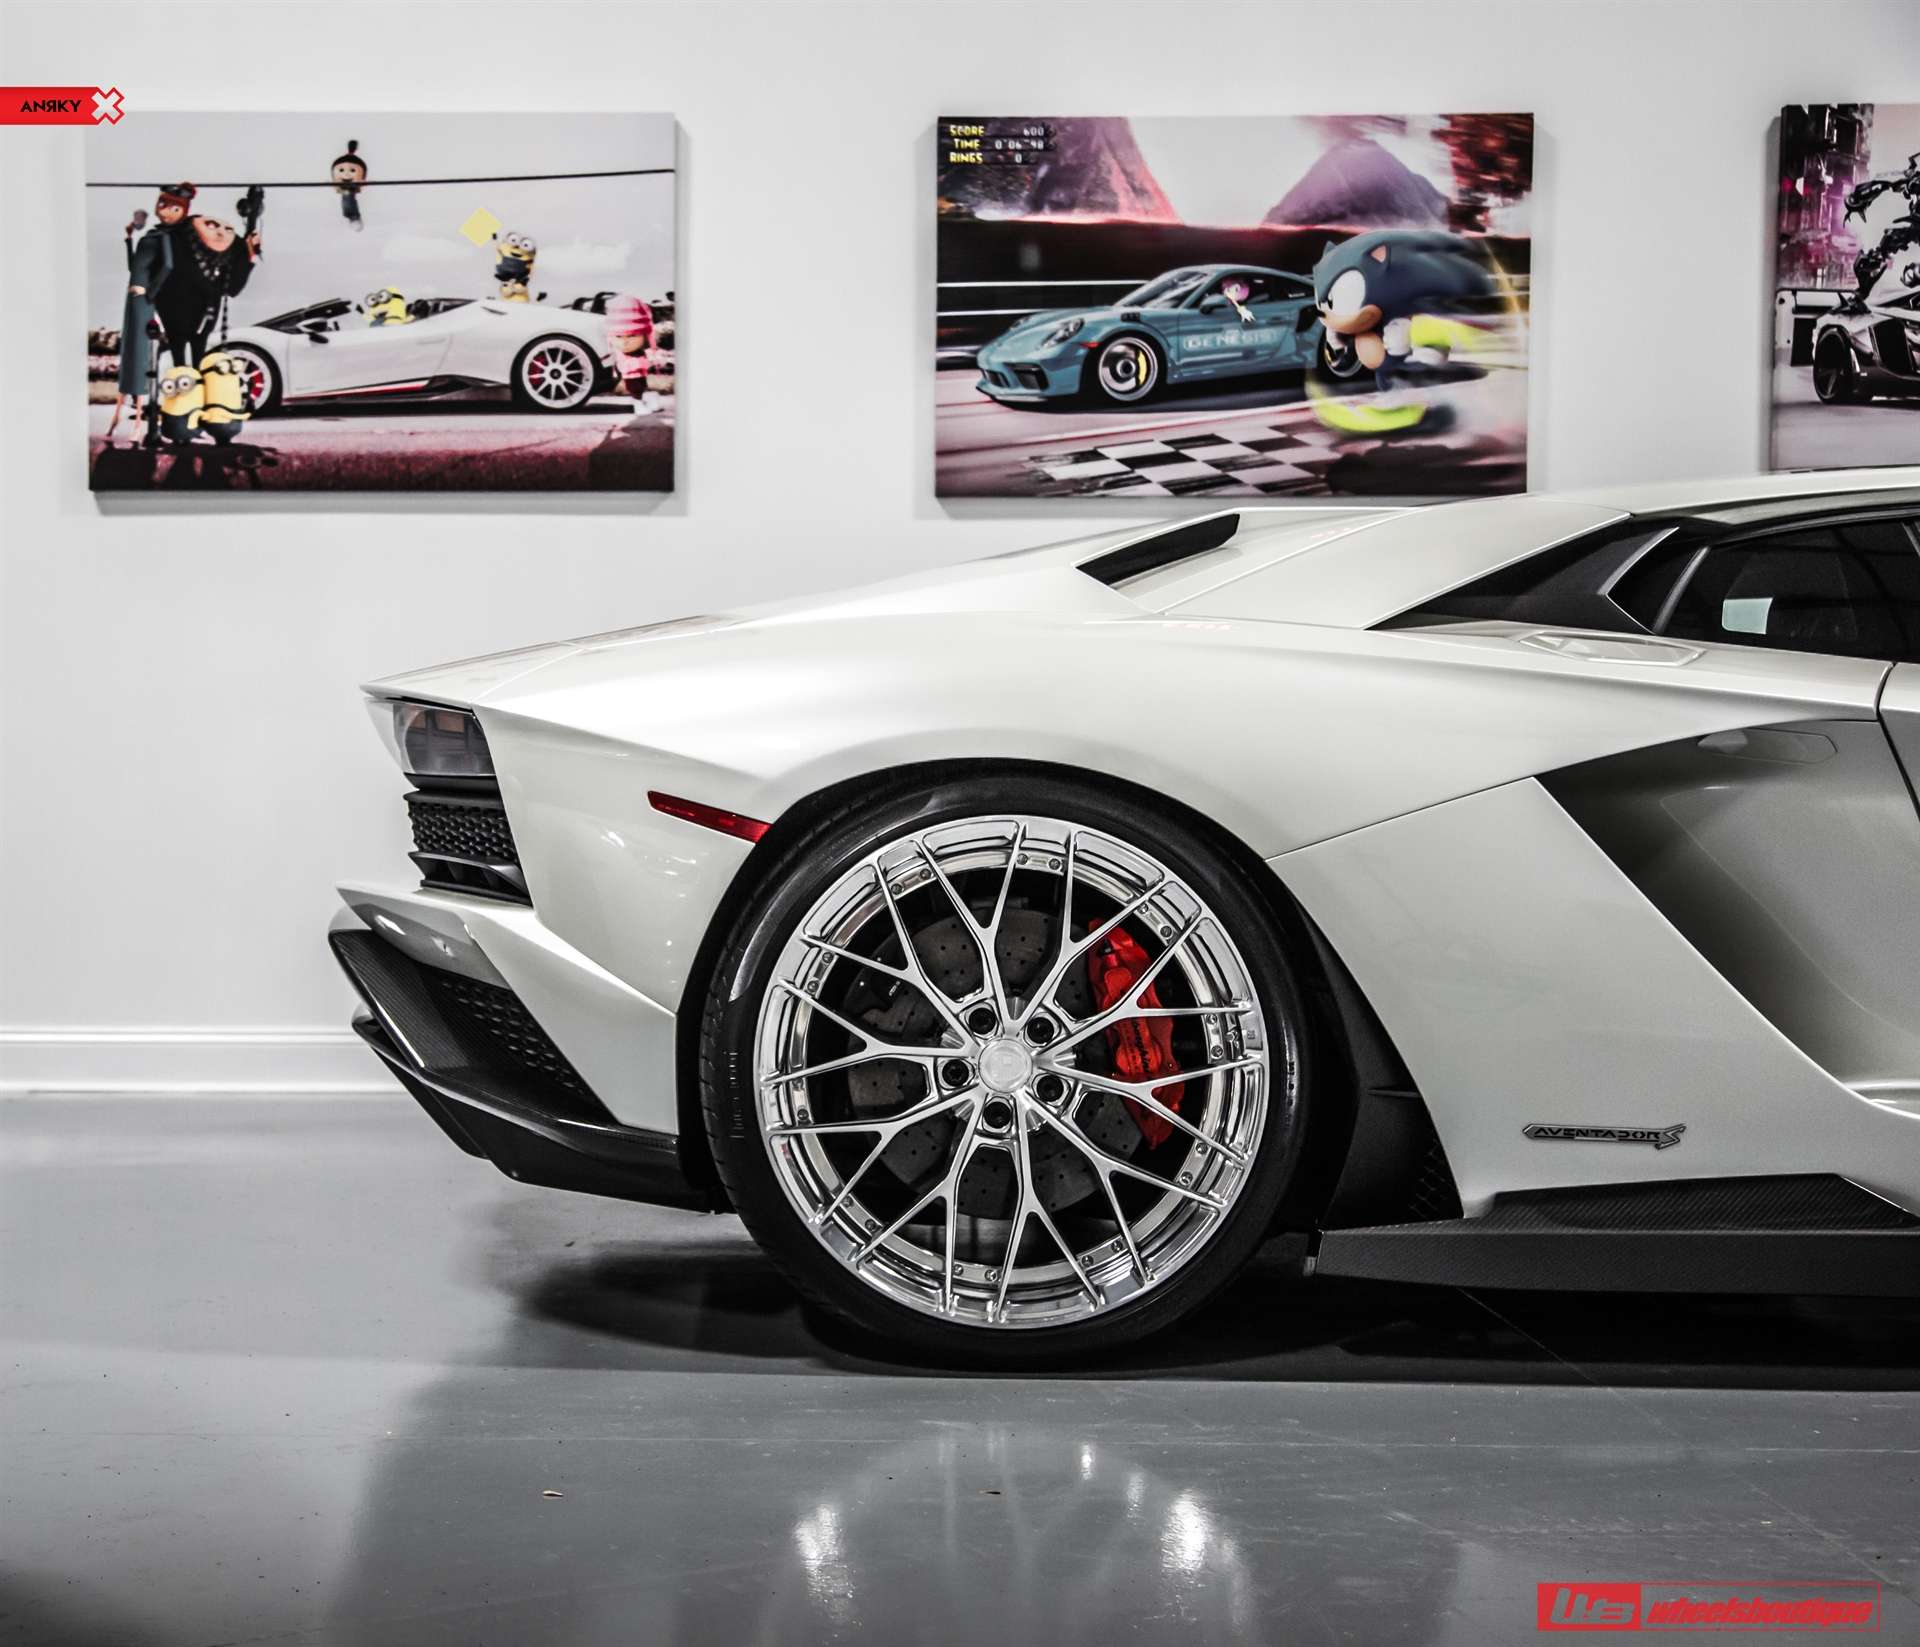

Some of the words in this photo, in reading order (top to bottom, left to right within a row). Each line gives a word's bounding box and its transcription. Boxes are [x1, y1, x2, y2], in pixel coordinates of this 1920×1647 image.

[950, 125, 985, 137] SCORE
[1023, 126, 1044, 136] 600
[954, 138, 980, 151] TIME
[950, 152, 983, 164] RINGS
[1186, 329, 1274, 347] GENESIS
